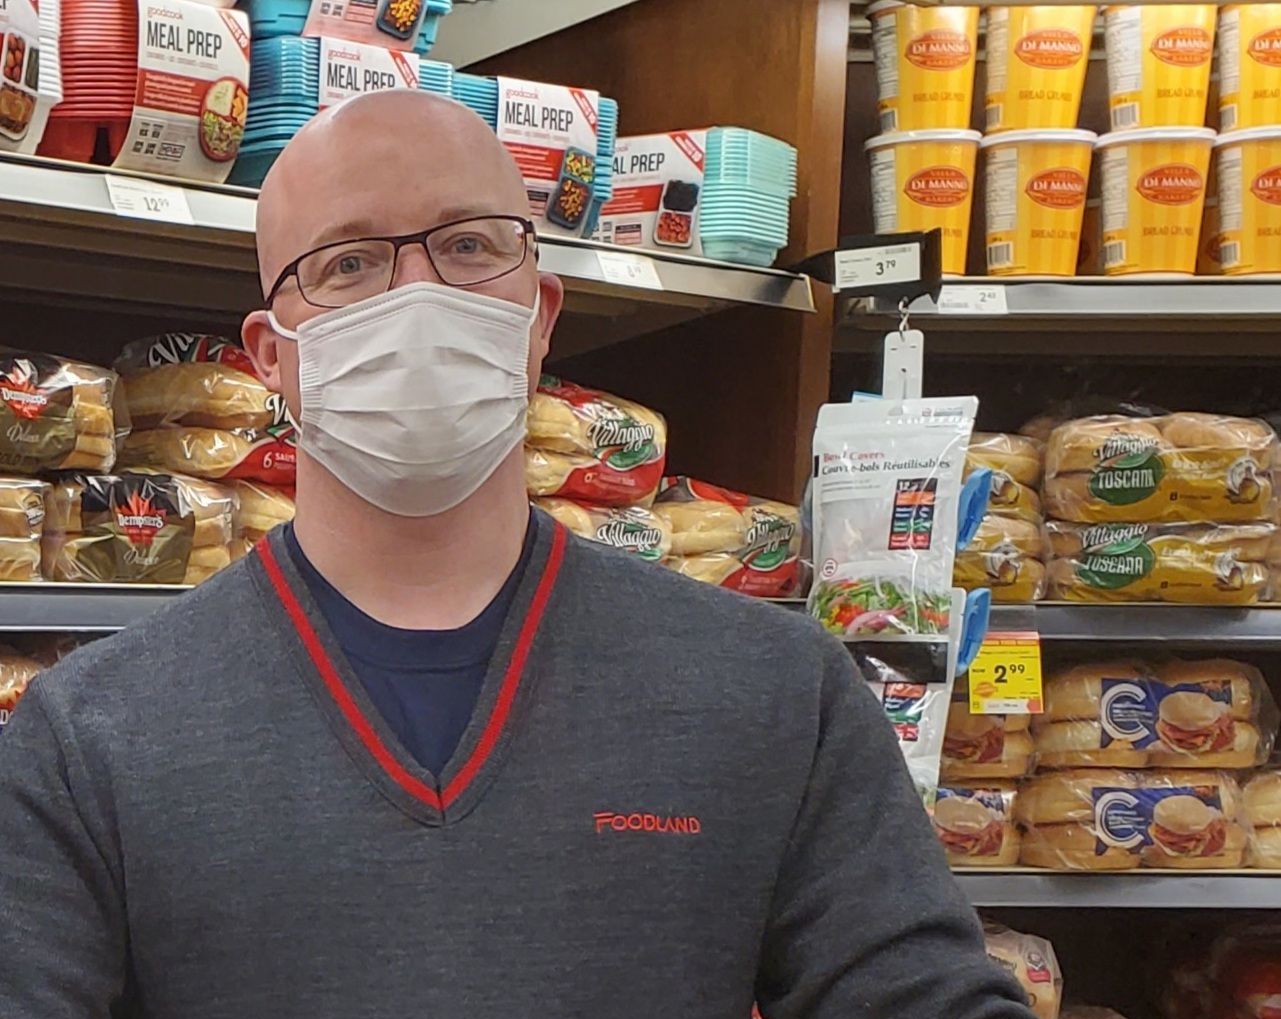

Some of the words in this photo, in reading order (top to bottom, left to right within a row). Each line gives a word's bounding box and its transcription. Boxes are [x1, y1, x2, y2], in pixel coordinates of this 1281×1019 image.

[147, 21, 183, 53] MEAL
[187, 30, 222, 58] PREP
[327, 62, 359, 91] MEAL
[505, 101, 538, 127] MEAL
[542, 107, 574, 132] PREP
[631, 153, 665, 173] PREP
[587, 419, 654, 452] Villaggio
[597, 519, 662, 552] Villaggio
[1080, 523, 1149, 549] Villaggio
[1086, 556, 1144, 575] TOSCANA
[593, 812, 702, 834] FOODLAND
